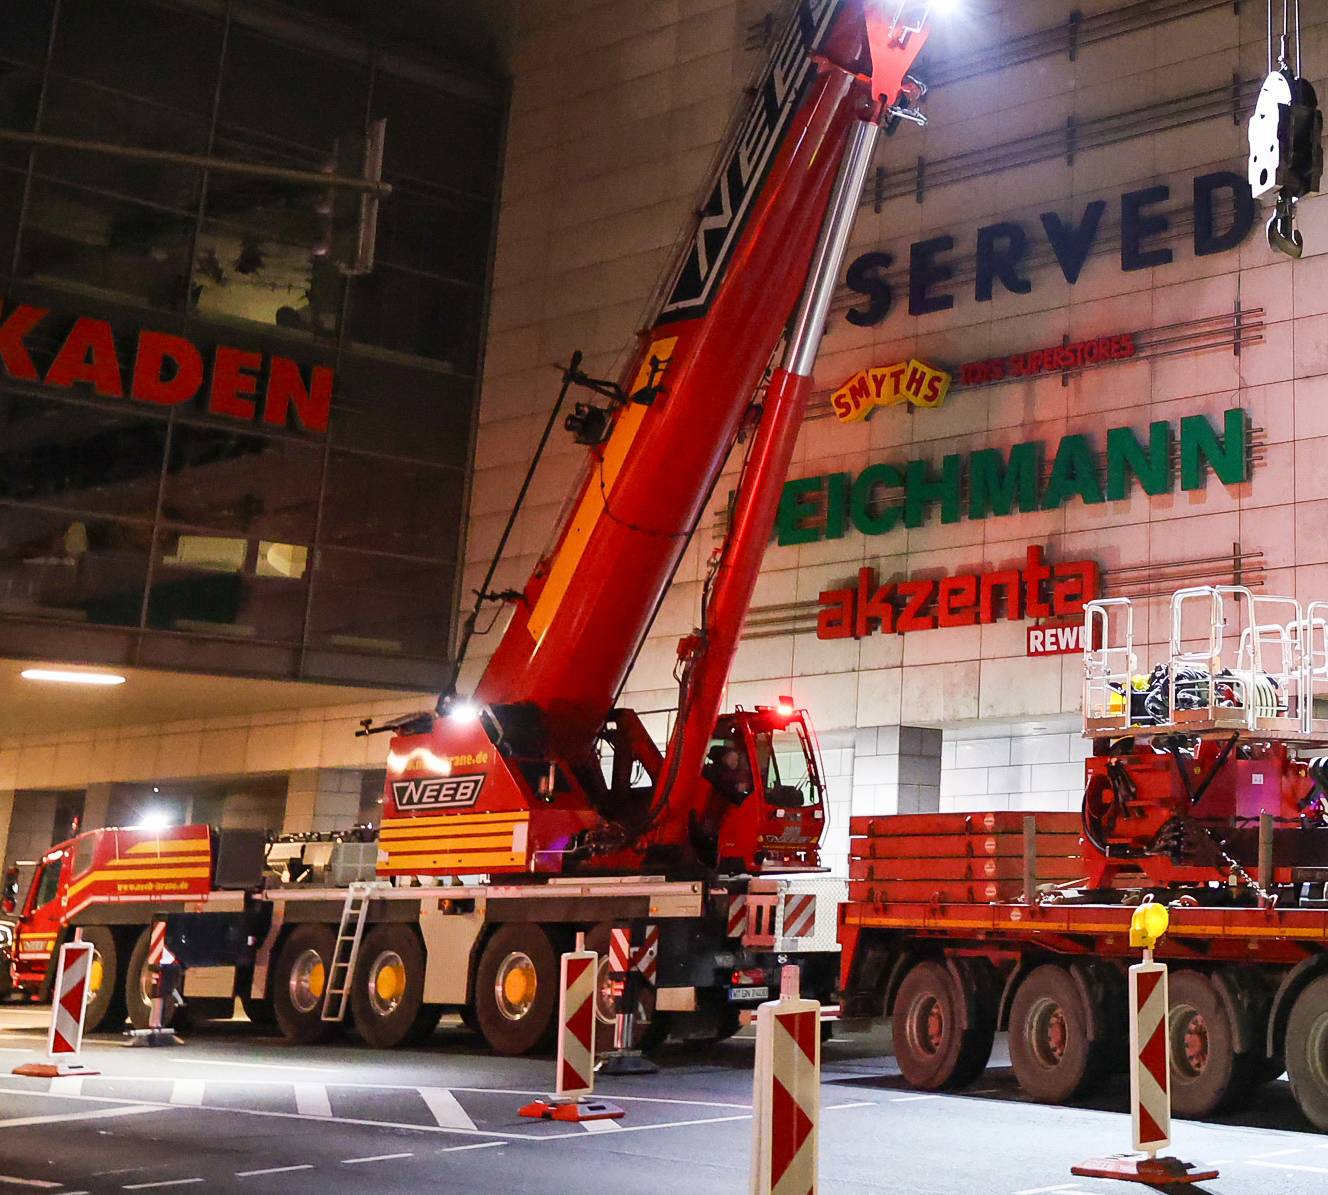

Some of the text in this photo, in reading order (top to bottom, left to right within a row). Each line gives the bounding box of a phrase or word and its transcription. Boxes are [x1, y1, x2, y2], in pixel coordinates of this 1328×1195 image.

[833, 334, 1136, 418] SMYTHS TOYS SUPERSTORES
[817, 544, 1099, 640] akzenta
[402, 781, 475, 804] NEEB
